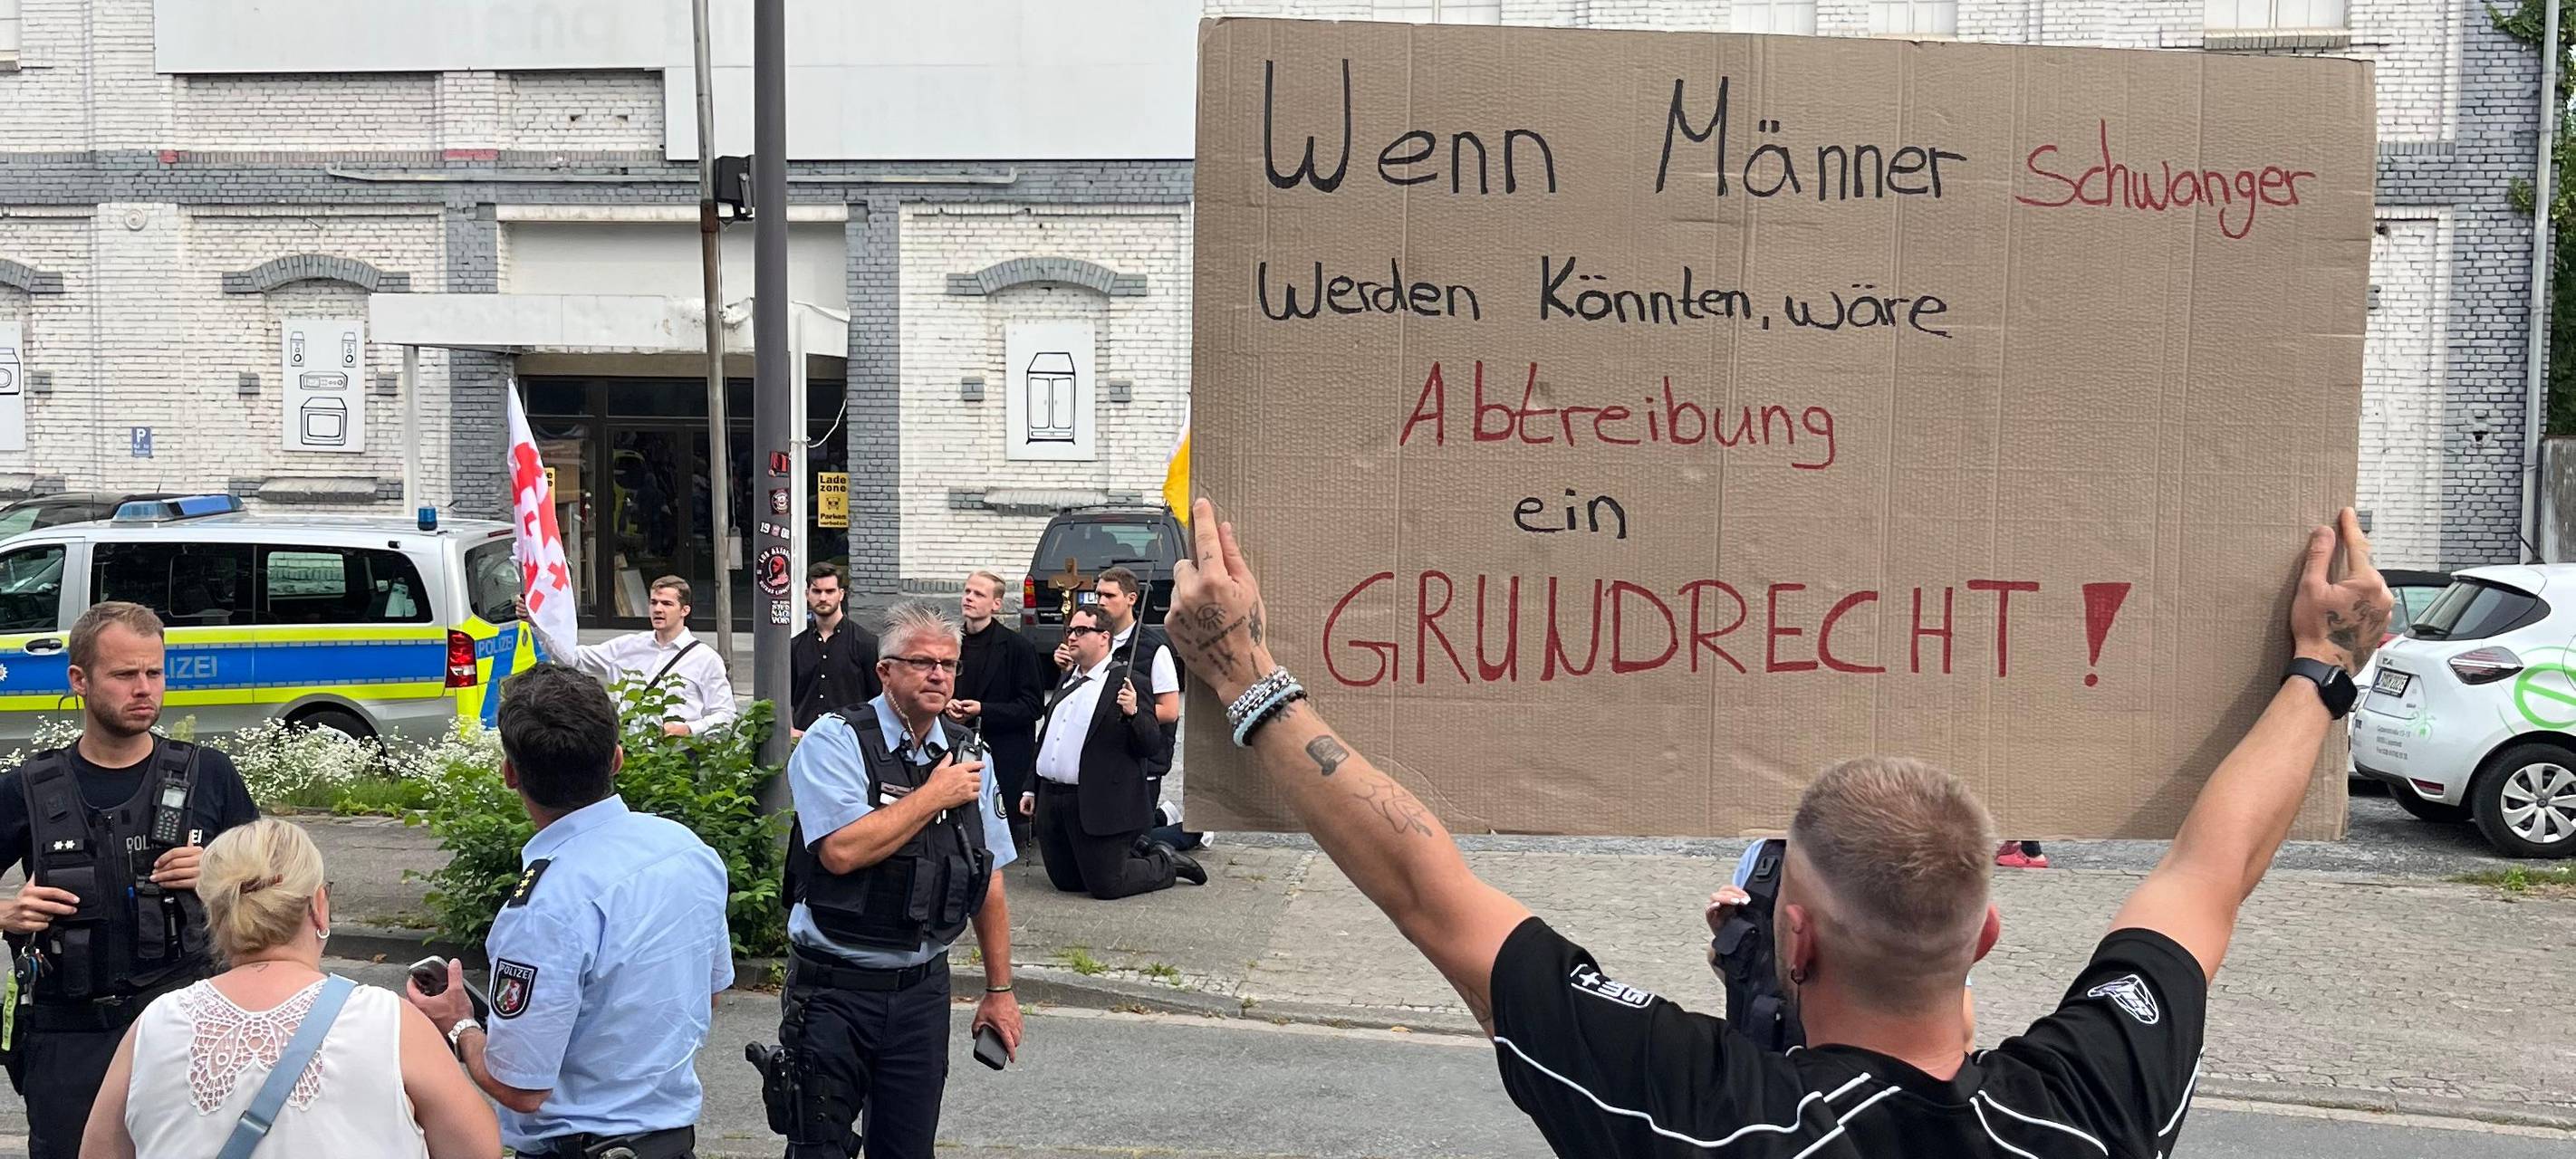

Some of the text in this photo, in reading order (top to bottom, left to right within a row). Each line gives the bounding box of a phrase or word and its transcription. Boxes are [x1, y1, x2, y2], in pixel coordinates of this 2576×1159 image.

[1264, 58, 2316, 240] Wenn Männer Schwanger
[1257, 257, 1481, 321] Werden
[1784, 286, 1953, 339] wäre
[1399, 361, 1835, 471] Abtreibung
[820, 475, 847, 484] Lade
[820, 484, 847, 493] zone
[1514, 488, 1628, 540] ein
[1322, 570, 2040, 686] GRUNDRECHT
[499, 963, 532, 980] POLIZEI
